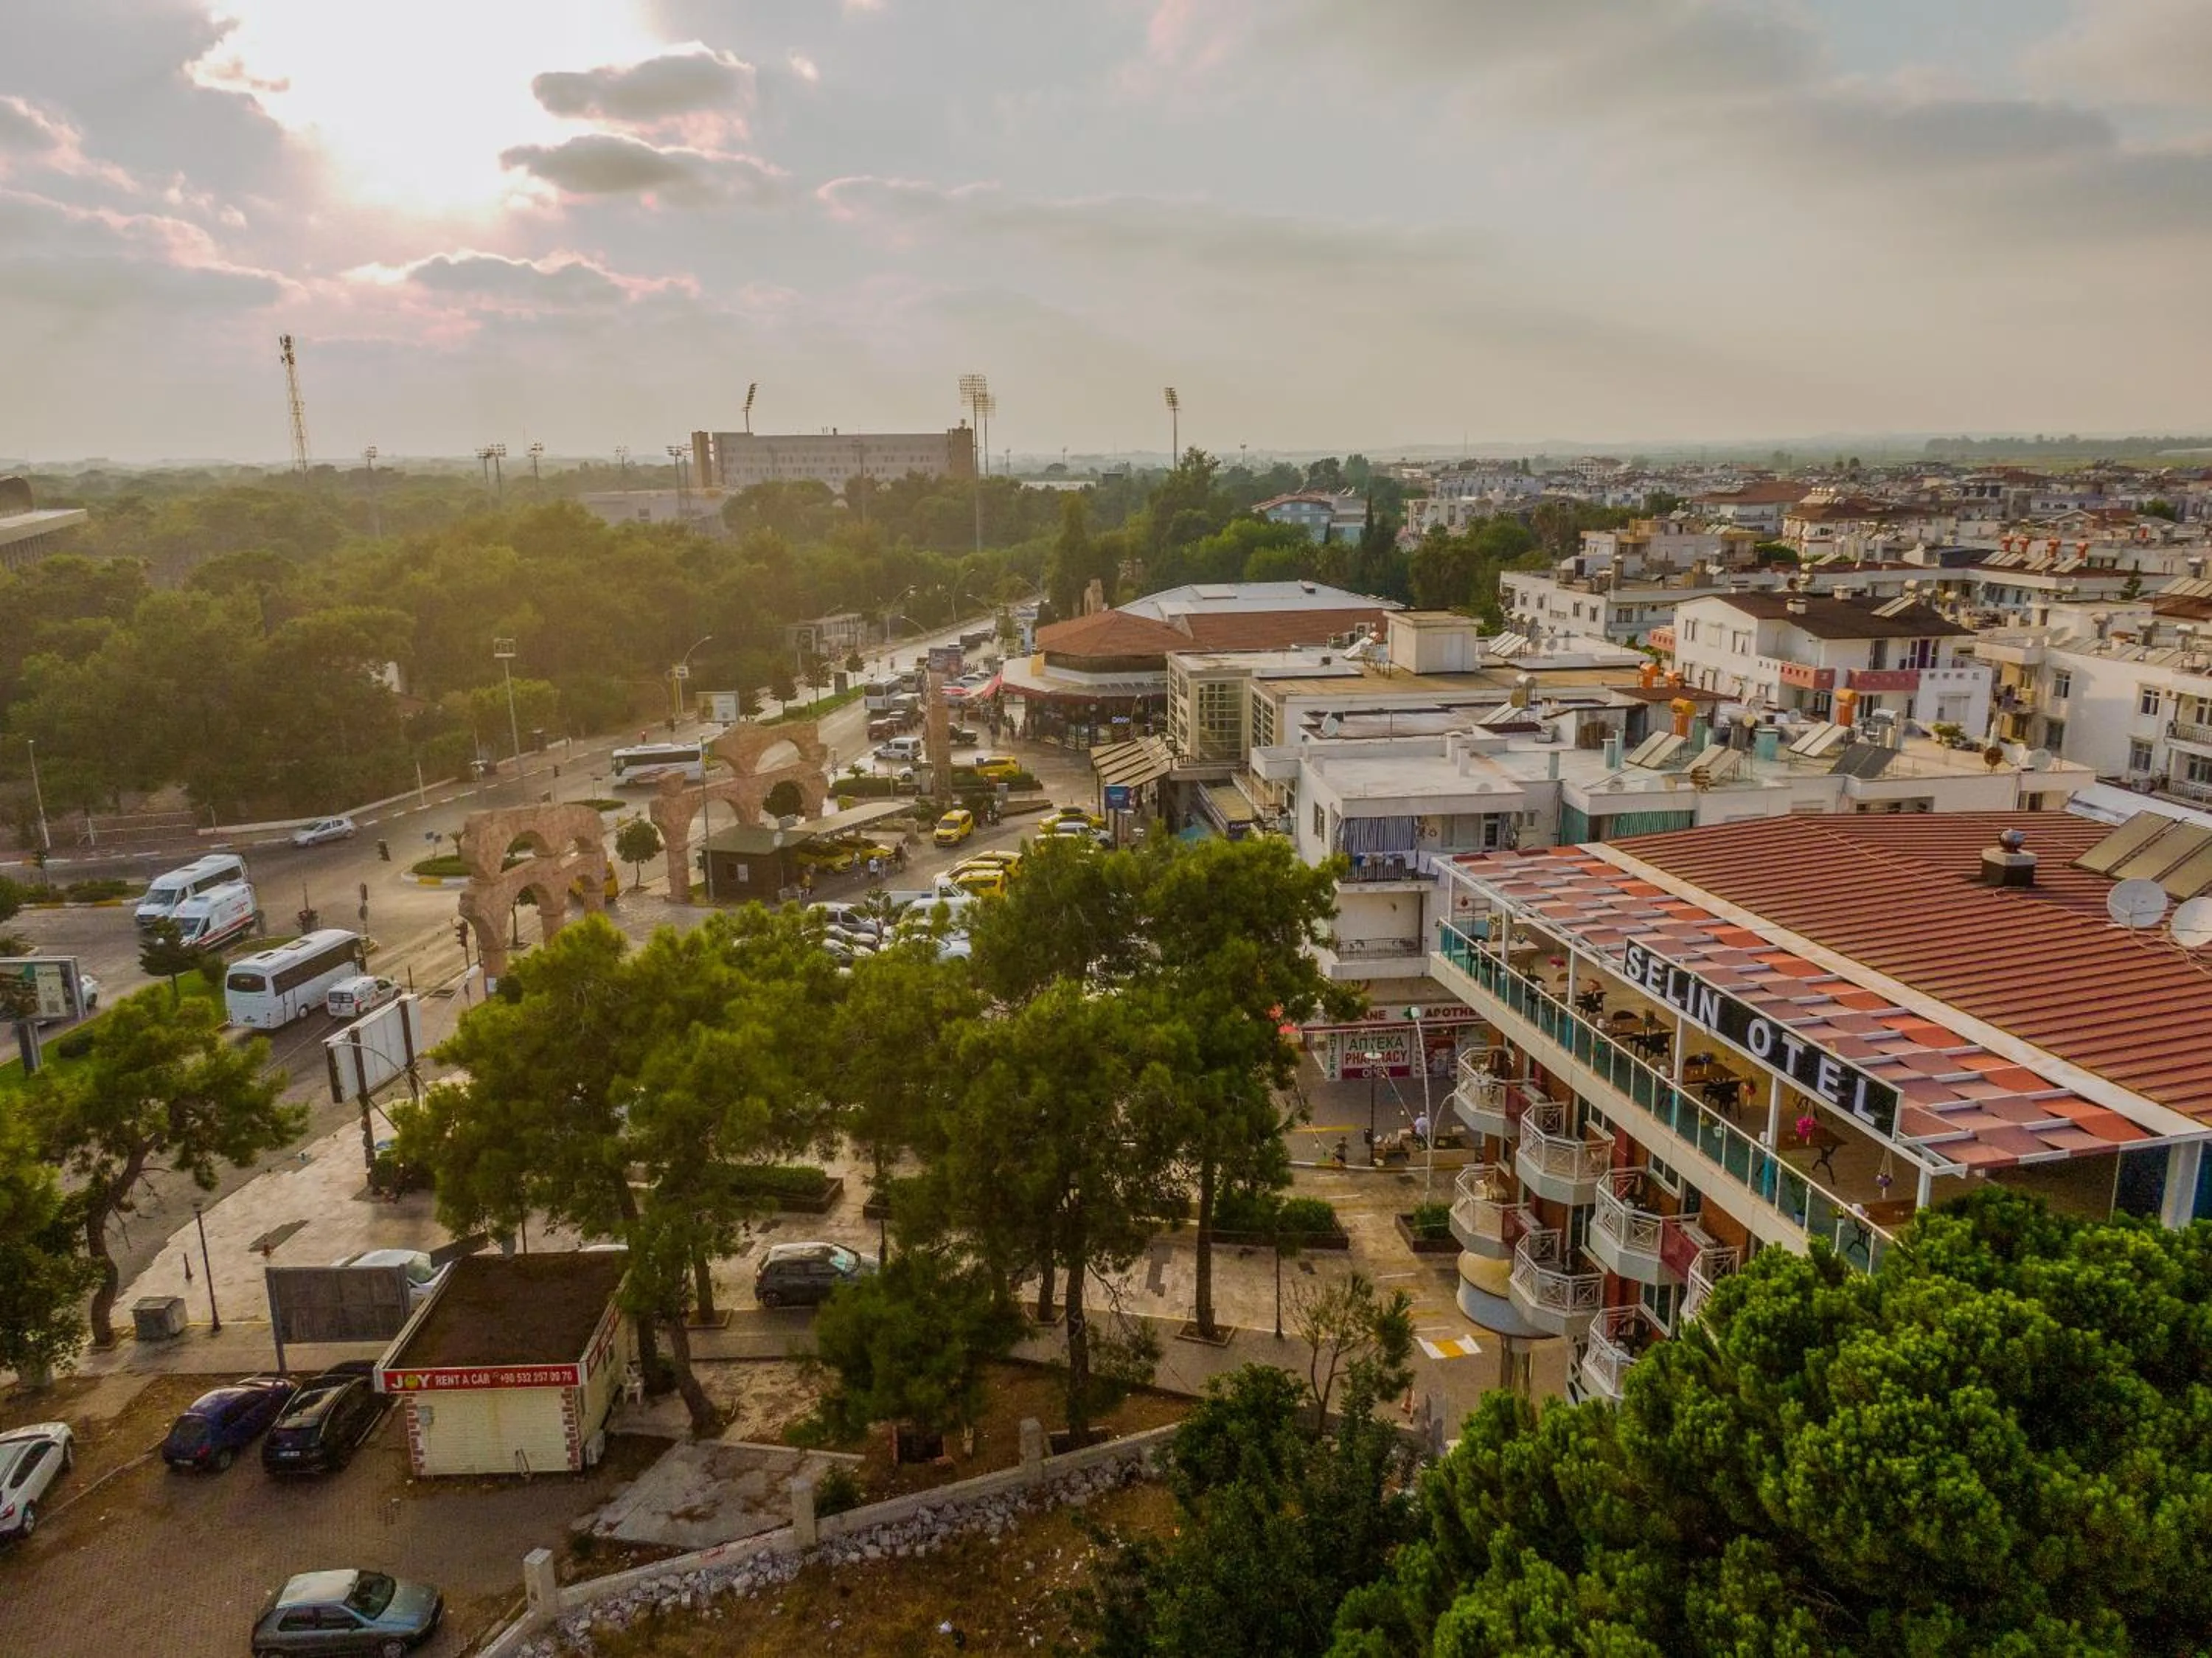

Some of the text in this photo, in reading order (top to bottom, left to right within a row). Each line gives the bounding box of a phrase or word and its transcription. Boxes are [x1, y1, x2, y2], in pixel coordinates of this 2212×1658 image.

[1345, 1050, 1408, 1064] PHAACY
[1747, 1019, 1875, 1126] OTEL
[435, 1375, 460, 1386] RENT
[462, 1374, 470, 1385] A
[471, 1373, 490, 1384] CAR
